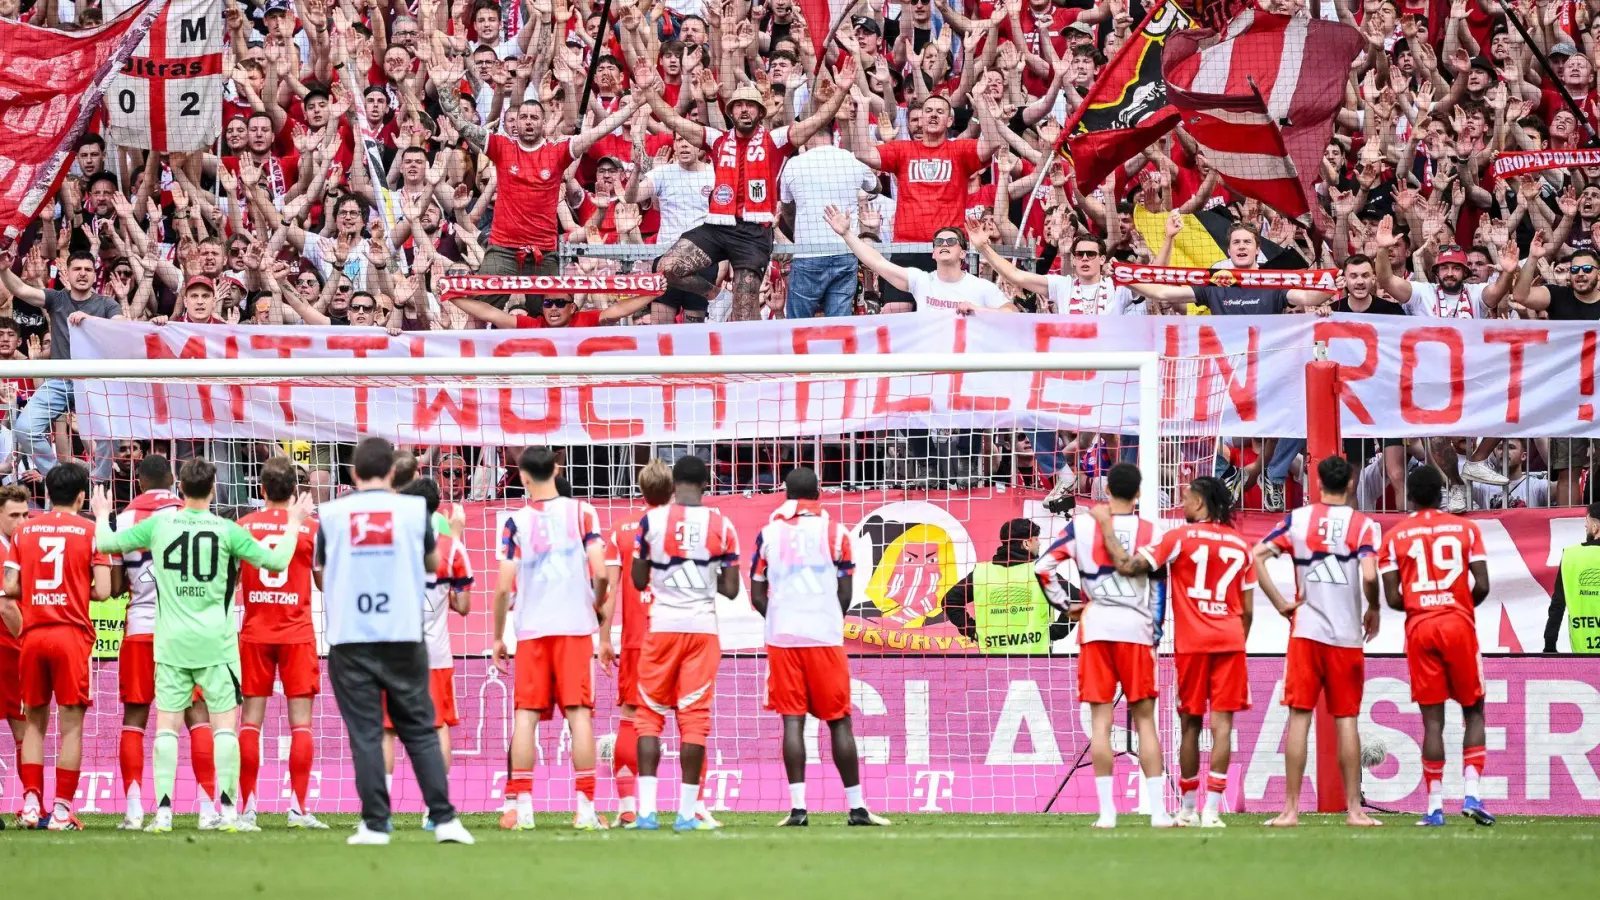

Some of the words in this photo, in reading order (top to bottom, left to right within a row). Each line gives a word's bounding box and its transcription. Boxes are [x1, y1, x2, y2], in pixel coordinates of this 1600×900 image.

[180, 16, 206, 43] M
[180, 92, 200, 116] 2
[1493, 151, 1600, 177] UROPAPOKALS
[792, 318, 1098, 424] ALLE
[1160, 324, 1260, 422] IN
[35, 536, 66, 589] 3
[163, 531, 219, 582] 40
[1407, 536, 1464, 593] 19
[1187, 544, 1245, 601] 17
[31, 593, 67, 606] MINJAE
[176, 586, 206, 597] URBIG
[249, 591, 299, 605] GORETZKA
[357, 593, 391, 614] 02
[91, 619, 126, 631] TEWA
[985, 631, 1043, 648] STEWARD
[913, 770, 955, 812] T
